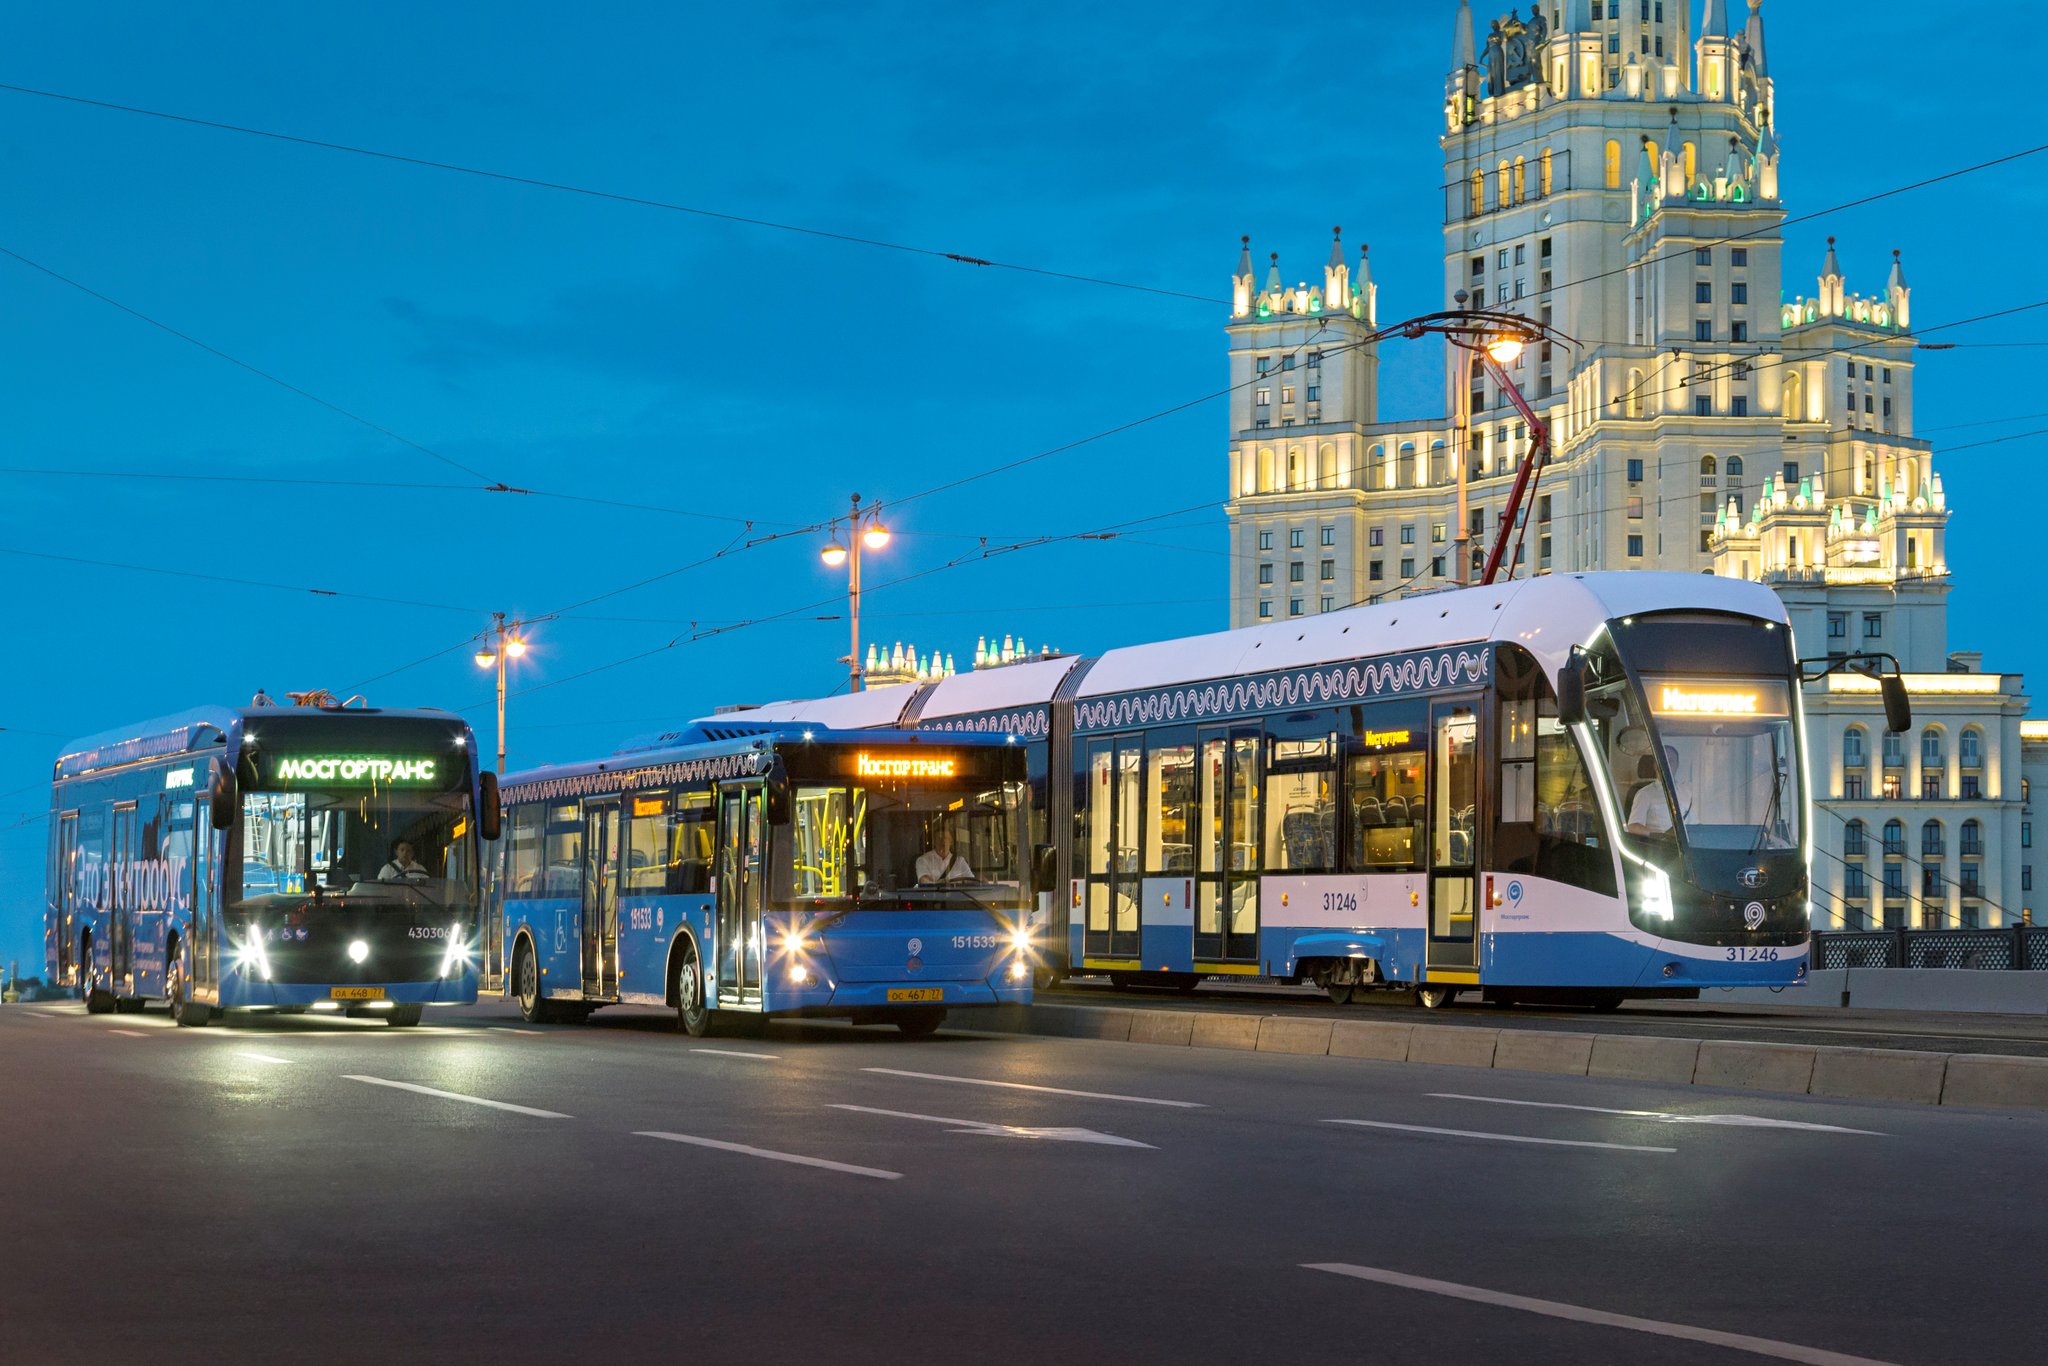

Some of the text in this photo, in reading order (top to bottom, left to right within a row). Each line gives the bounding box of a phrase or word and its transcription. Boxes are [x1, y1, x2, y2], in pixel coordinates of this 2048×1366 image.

[278, 759, 434, 780] МОСГОРТРАНС
[858, 753, 954, 776] Мосгортранс
[1323, 893, 1357, 911] 31246
[630, 907, 652, 930] 151533
[408, 927, 451, 939] 430306
[951, 936, 996, 949] 151533
[1726, 947, 1778, 961] 31246
[350, 988, 368, 998] 448
[908, 990, 926, 1000] 467
